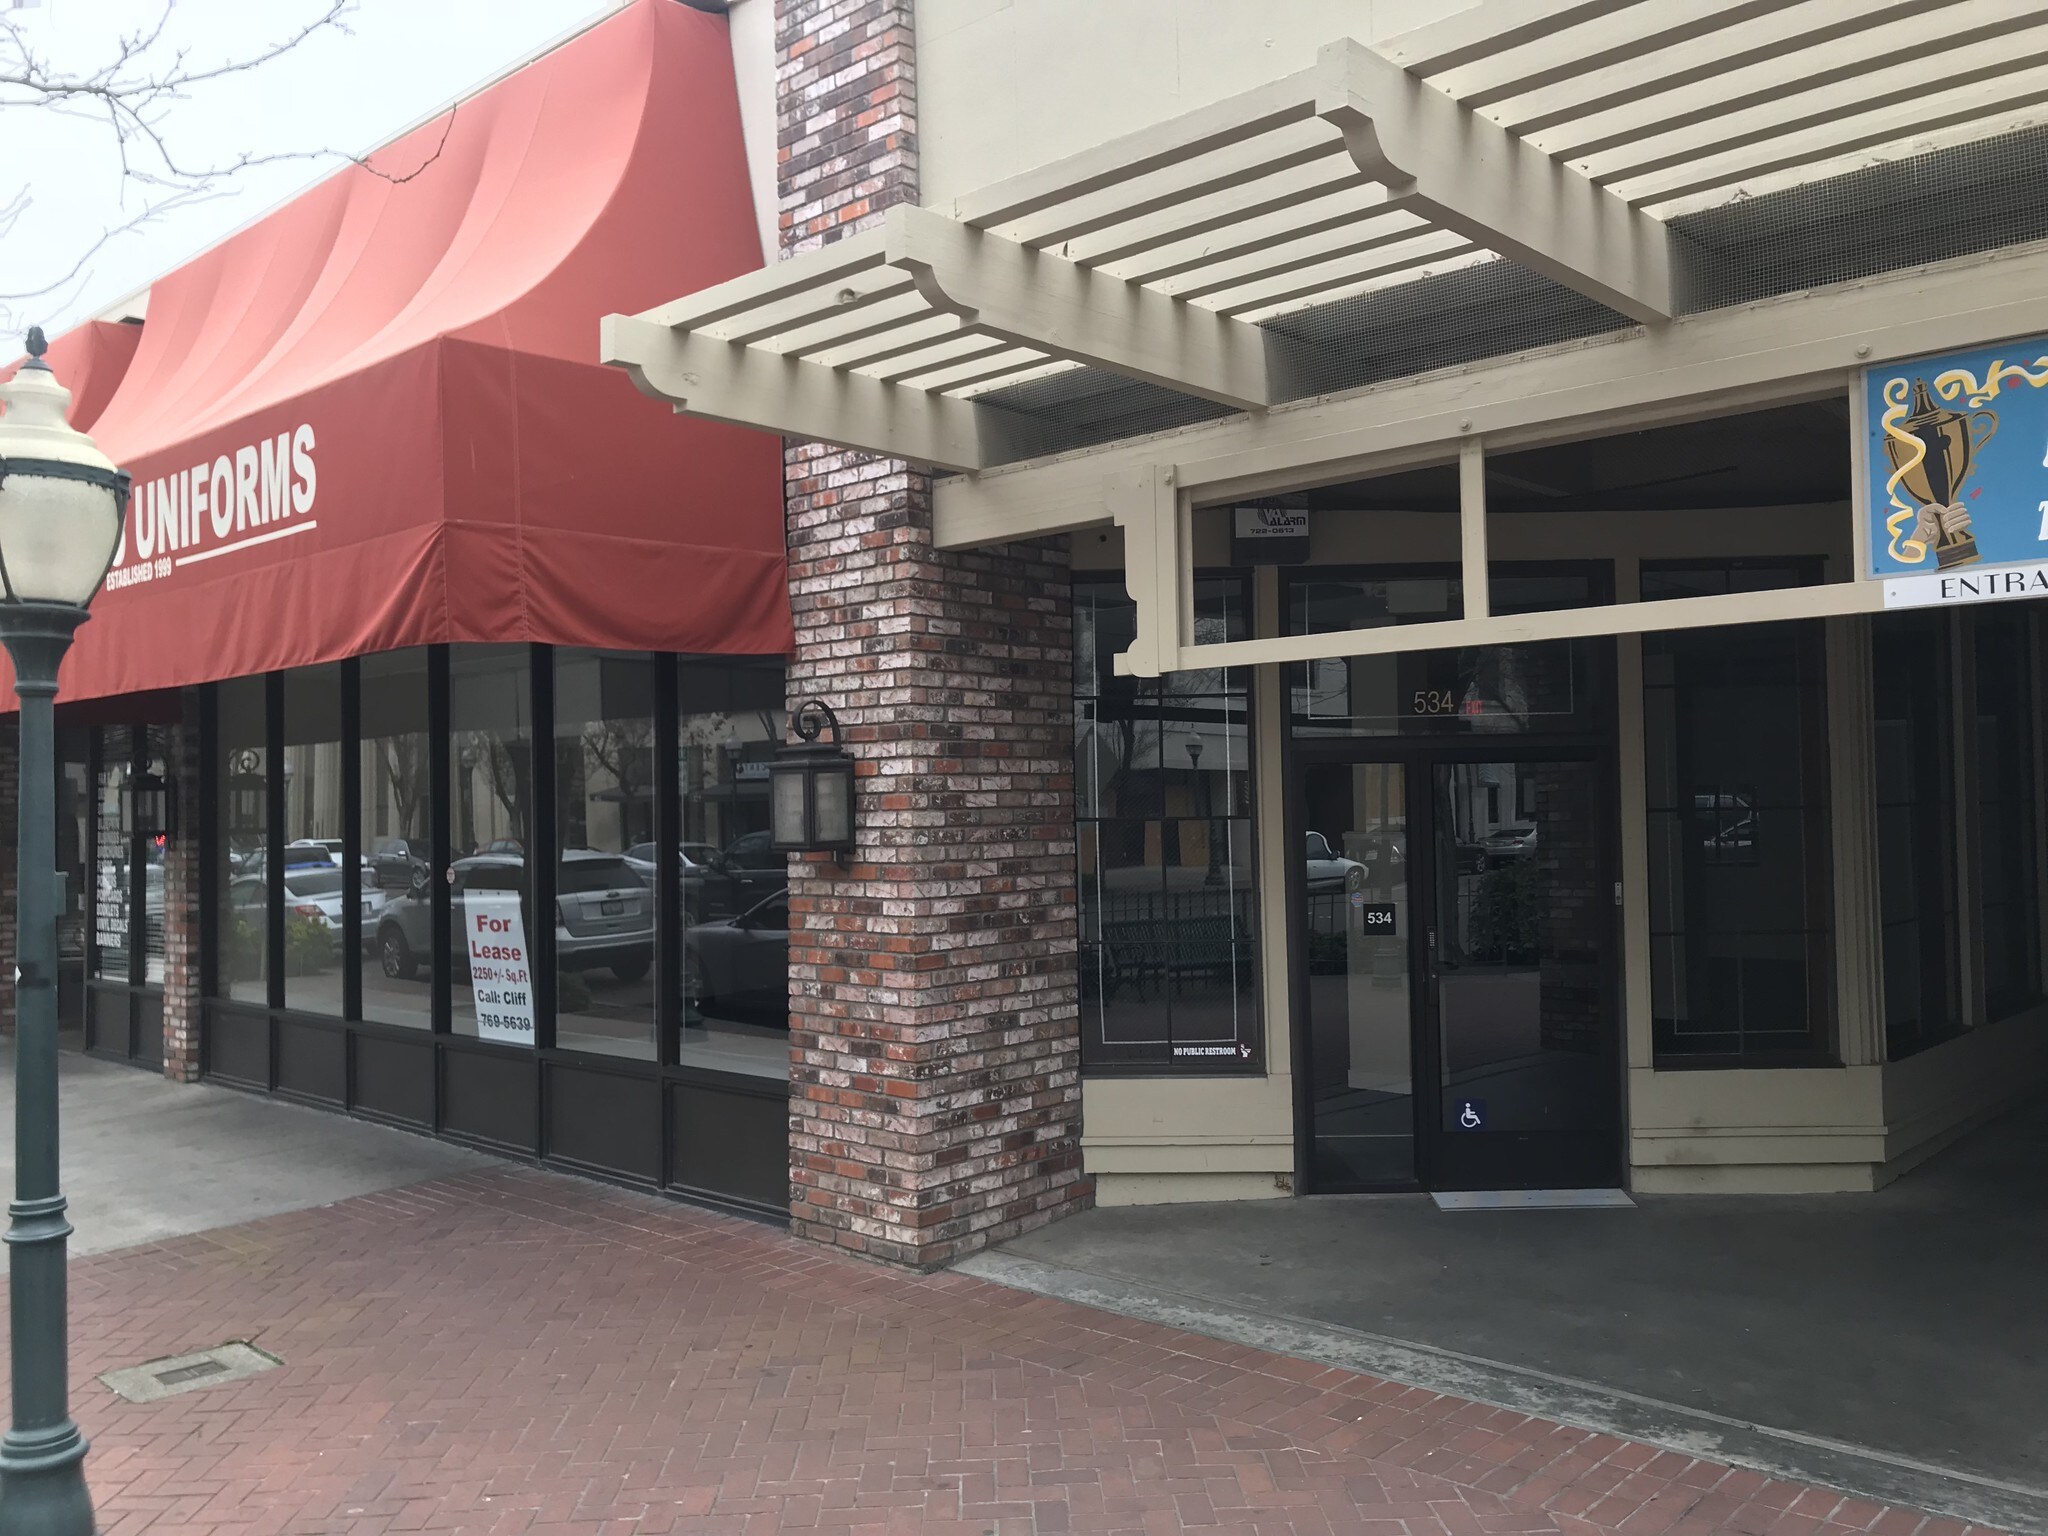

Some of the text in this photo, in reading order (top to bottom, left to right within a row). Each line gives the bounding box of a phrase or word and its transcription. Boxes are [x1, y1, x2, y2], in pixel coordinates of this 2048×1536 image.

[135, 423, 316, 559] UNIFORMS
[106, 556, 172, 592] ESTABLISHED 1999
[1414, 690, 1454, 713] 534
[1465, 700, 1483, 715] EXIT
[476, 914, 511, 933] For
[1367, 911, 1393, 924] 534
[96, 931, 122, 948] BANNERS
[471, 940, 522, 961] Lease
[478, 989, 527, 1006] Call: Cliff
[480, 1013, 531, 1031] 769-5639
[1173, 1046, 1236, 1056] NO PUBLIC RESTROOM
